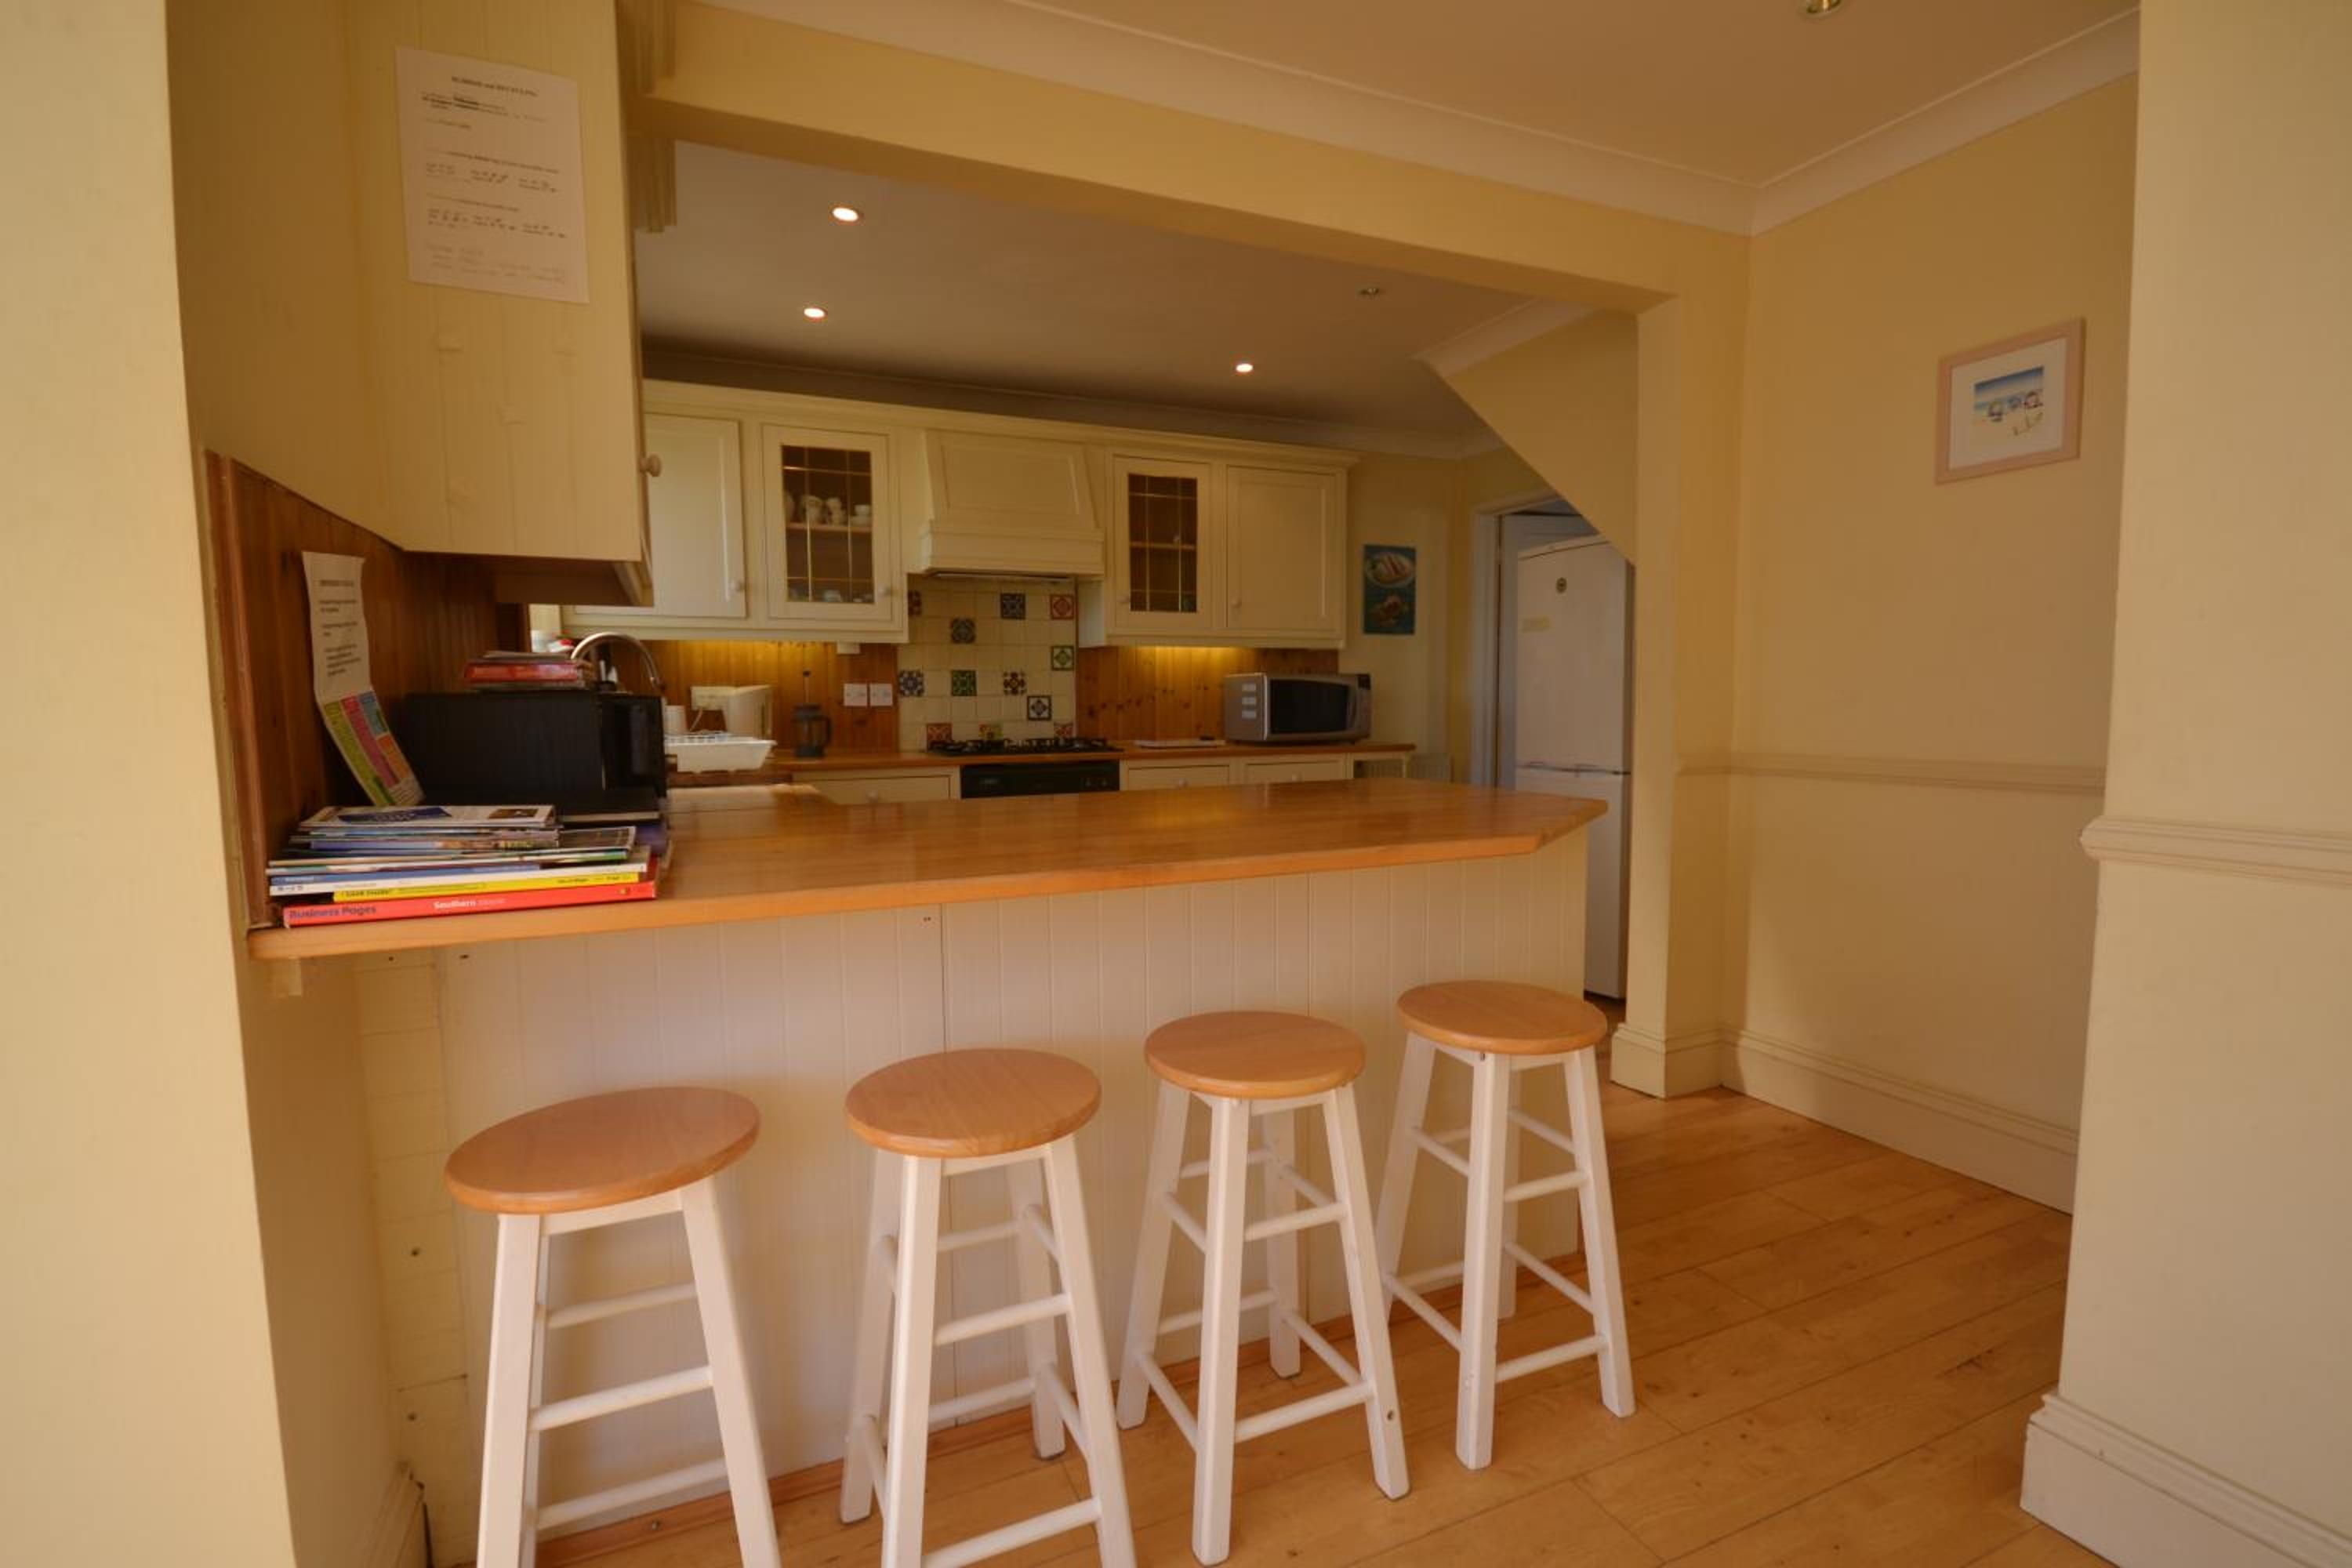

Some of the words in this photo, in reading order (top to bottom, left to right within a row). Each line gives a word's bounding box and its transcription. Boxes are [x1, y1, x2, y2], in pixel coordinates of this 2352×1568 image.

[433, 899, 477, 909] Southern
[289, 909, 339, 920] Business
[341, 906, 376, 917] Pages
